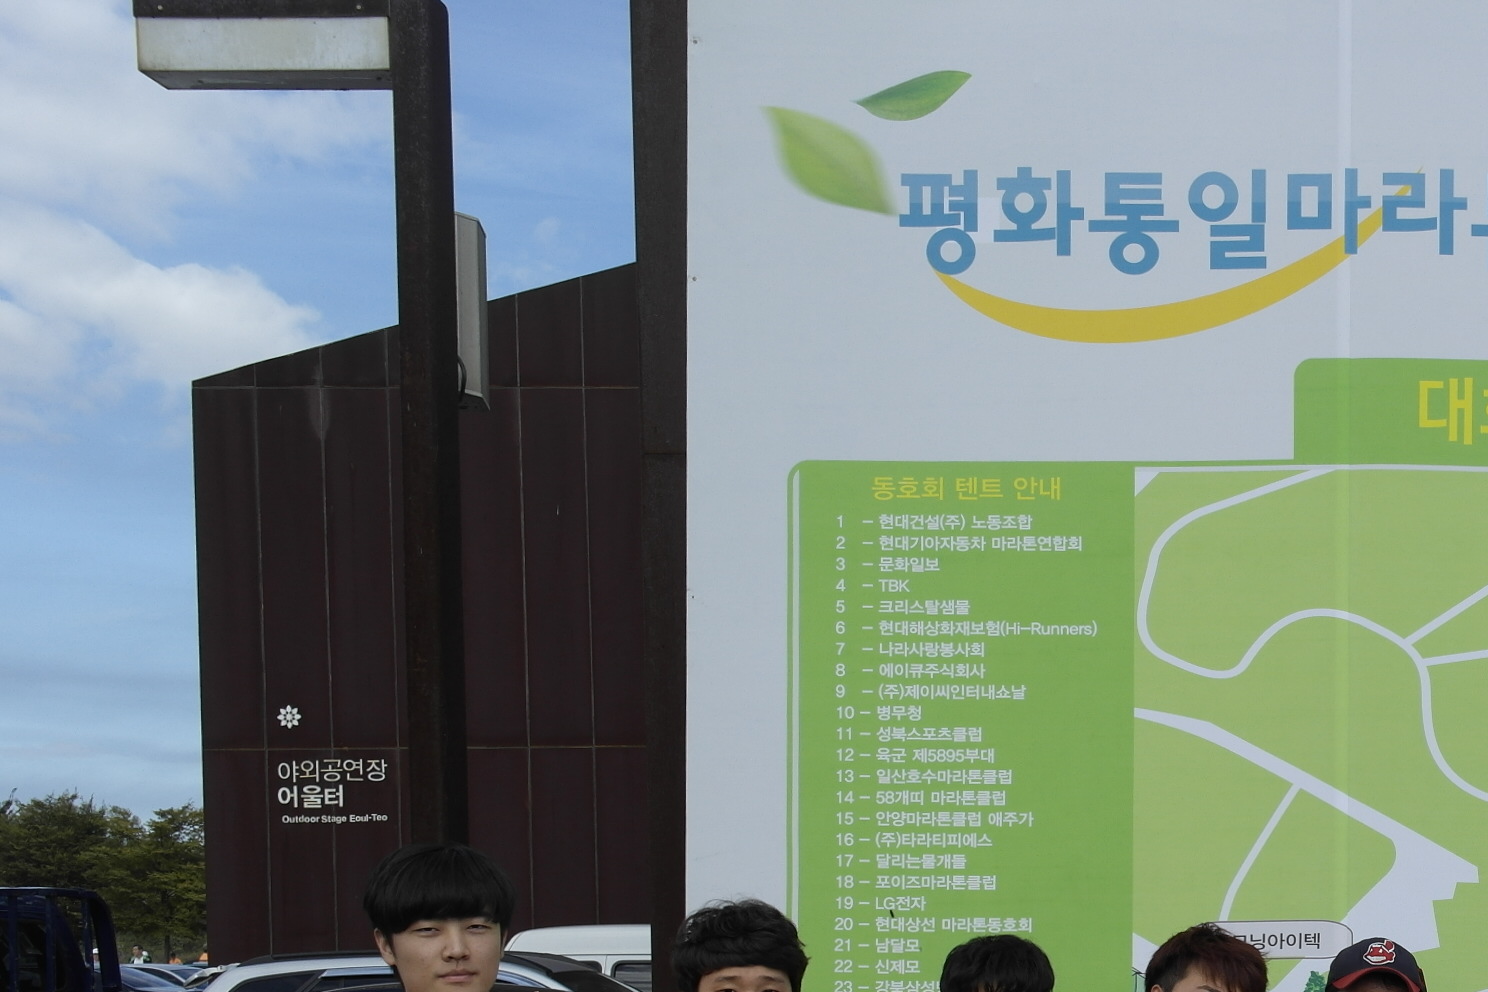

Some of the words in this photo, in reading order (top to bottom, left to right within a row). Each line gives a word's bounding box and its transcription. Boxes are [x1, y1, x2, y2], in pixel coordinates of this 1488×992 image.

[871, 476, 944, 501] 동호회
[956, 476, 1004, 501] 텐트
[1013, 476, 1062, 501] 안내
[837, 515, 843, 528] 1
[879, 514, 966, 530] 현대건설(주)
[971, 514, 1033, 530] 노동조합
[836, 536, 845, 549] 2
[879, 535, 986, 552] 현대기아자동차
[992, 535, 1082, 552] 마라톤연합회
[836, 557, 845, 570] 3
[879, 557, 940, 572] 문화일보
[836, 579, 846, 592] 4
[878, 579, 910, 592] TBK
[836, 600, 845, 613] 5
[878, 599, 970, 615] 크리스탈샘물
[836, 621, 845, 634] 6
[836, 642, 845, 655] 7
[879, 642, 985, 657] 나라사랑봉사회
[835, 663, 845, 676] 8
[879, 663, 986, 679] 에이큐주식회사
[836, 684, 845, 698] 9
[879, 684, 1027, 700] (주)제이씨인터내쇼날
[837, 706, 854, 719] 10
[877, 705, 921, 721] 병무청
[837, 727, 852, 740] 11
[876, 726, 982, 742] 성북스포츠클럽
[837, 748, 854, 761] 12
[876, 747, 907, 763] 육군
[912, 748, 995, 764] 제5895부대
[277, 758, 388, 783] 야외공연장
[837, 769, 854, 783] 13
[877, 769, 1012, 784] 일산호수마라톤클럽
[277, 784, 344, 808] 어울터
[837, 791, 855, 804] 14
[876, 790, 924, 805] 58개띠
[931, 790, 1006, 806] 마라톤클럽
[282, 814, 320, 824] Outdoor
[321, 814, 347, 824] Stage
[837, 812, 854, 825] 15
[876, 811, 981, 827] 안양마라톤클럽
[836, 833, 854, 846] 16
[875, 832, 992, 848] (주)타라티피에스
[836, 854, 854, 867] 17
[876, 853, 967, 869] 달리는물개들
[836, 875, 854, 888] 18
[836, 896, 853, 910] 19
[876, 896, 926, 911] LG전자
[834, 917, 853, 930] 20
[875, 917, 935, 932] 현대상선
[942, 917, 1032, 933] 마라톤동호회
[834, 938, 850, 952] 21
[875, 938, 920, 953] 남달모
[834, 960, 852, 973] 22
[875, 959, 920, 974] 신제모
